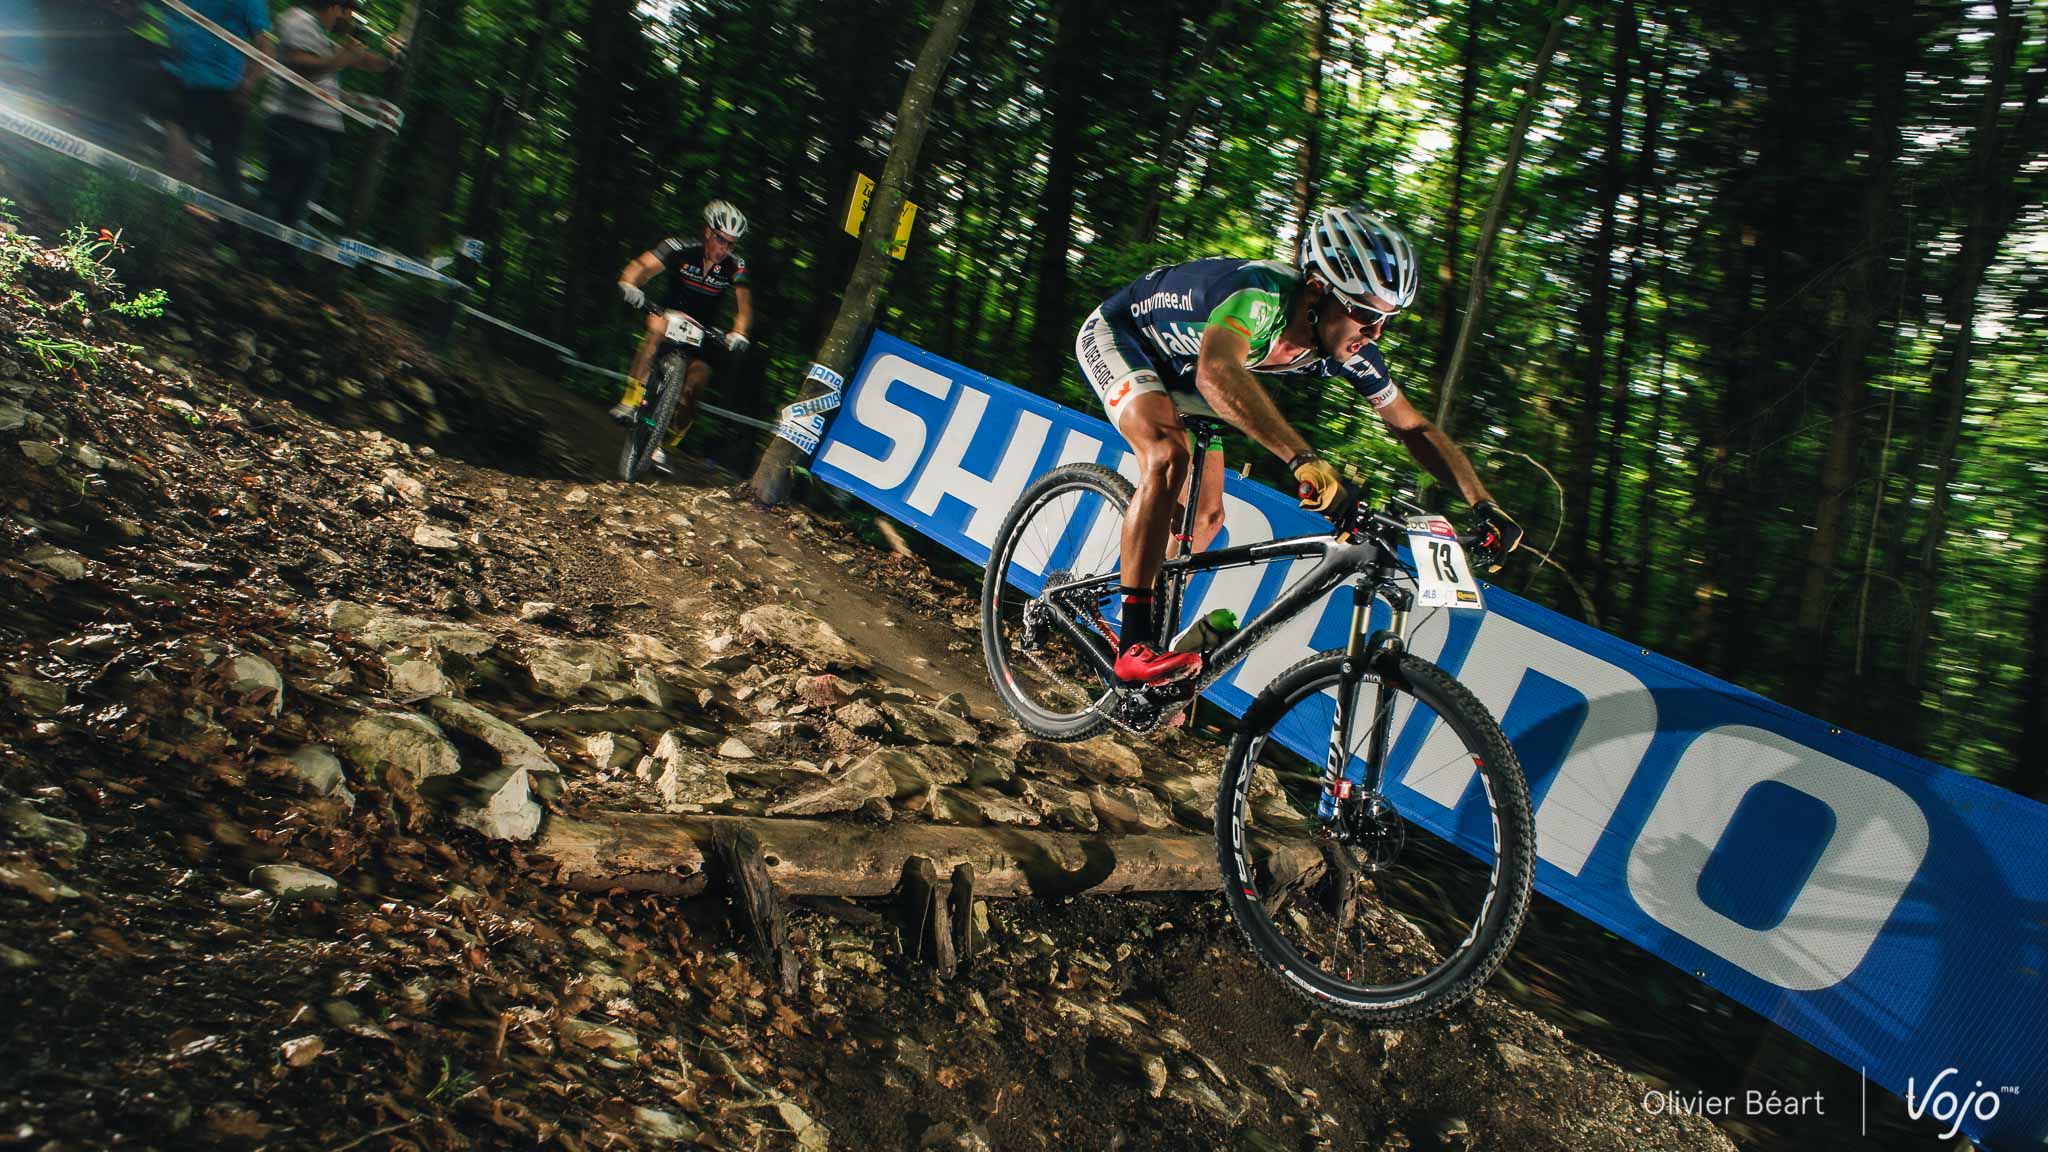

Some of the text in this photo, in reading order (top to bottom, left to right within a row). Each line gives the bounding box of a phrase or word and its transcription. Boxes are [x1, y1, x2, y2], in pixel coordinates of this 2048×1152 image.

[1085, 346, 1102, 368] DER
[1091, 359, 1114, 391] HEIDE
[1428, 541, 1460, 584] 73
[822, 354, 1930, 991] SHIMANO
